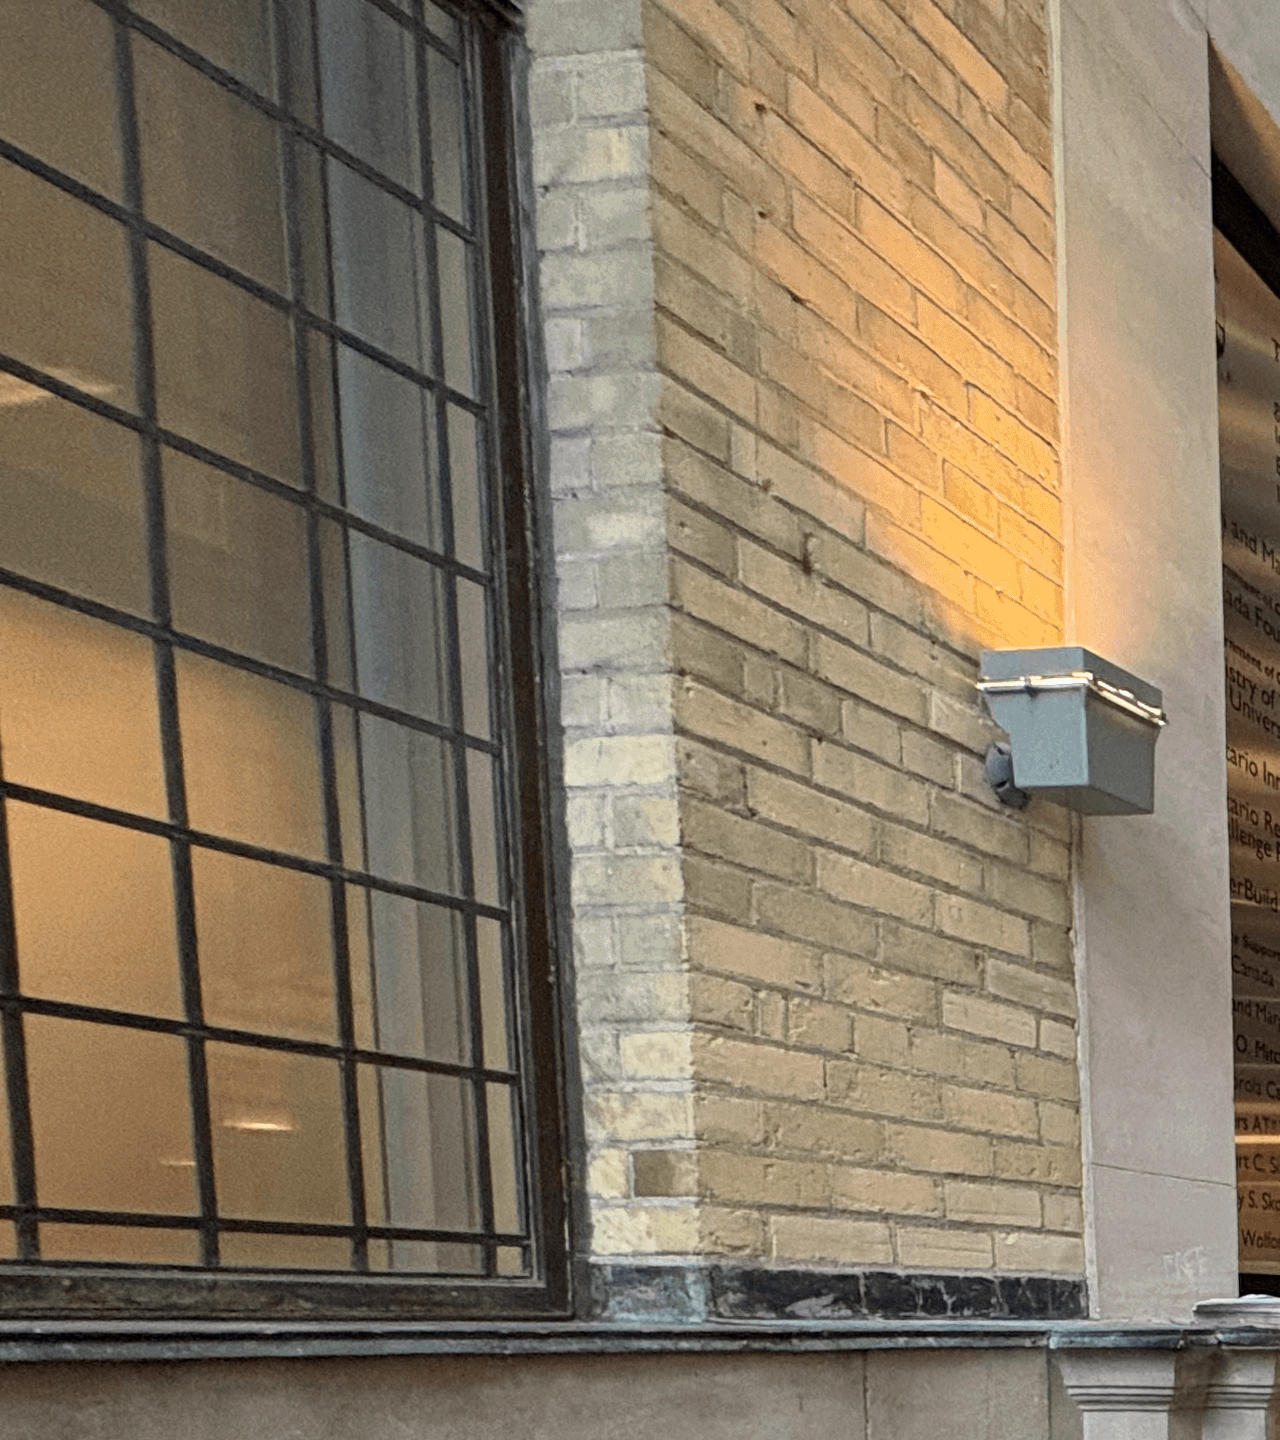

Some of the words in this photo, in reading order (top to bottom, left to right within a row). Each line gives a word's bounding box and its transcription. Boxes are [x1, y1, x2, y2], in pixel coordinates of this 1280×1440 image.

[1231, 521, 1257, 554] and
[1223, 589, 1250, 621] ada
[1225, 636, 1262, 672] rnment
[1264, 666, 1275, 680] of
[1226, 664, 1257, 705] istry
[1261, 689, 1276, 710] of
[1227, 745, 1259, 778] tario
[1228, 797, 1260, 826] tario
[1229, 817, 1273, 861] llenge
[1230, 877, 1278, 913] erBuild
[1248, 1190, 1259, 1209] S.
